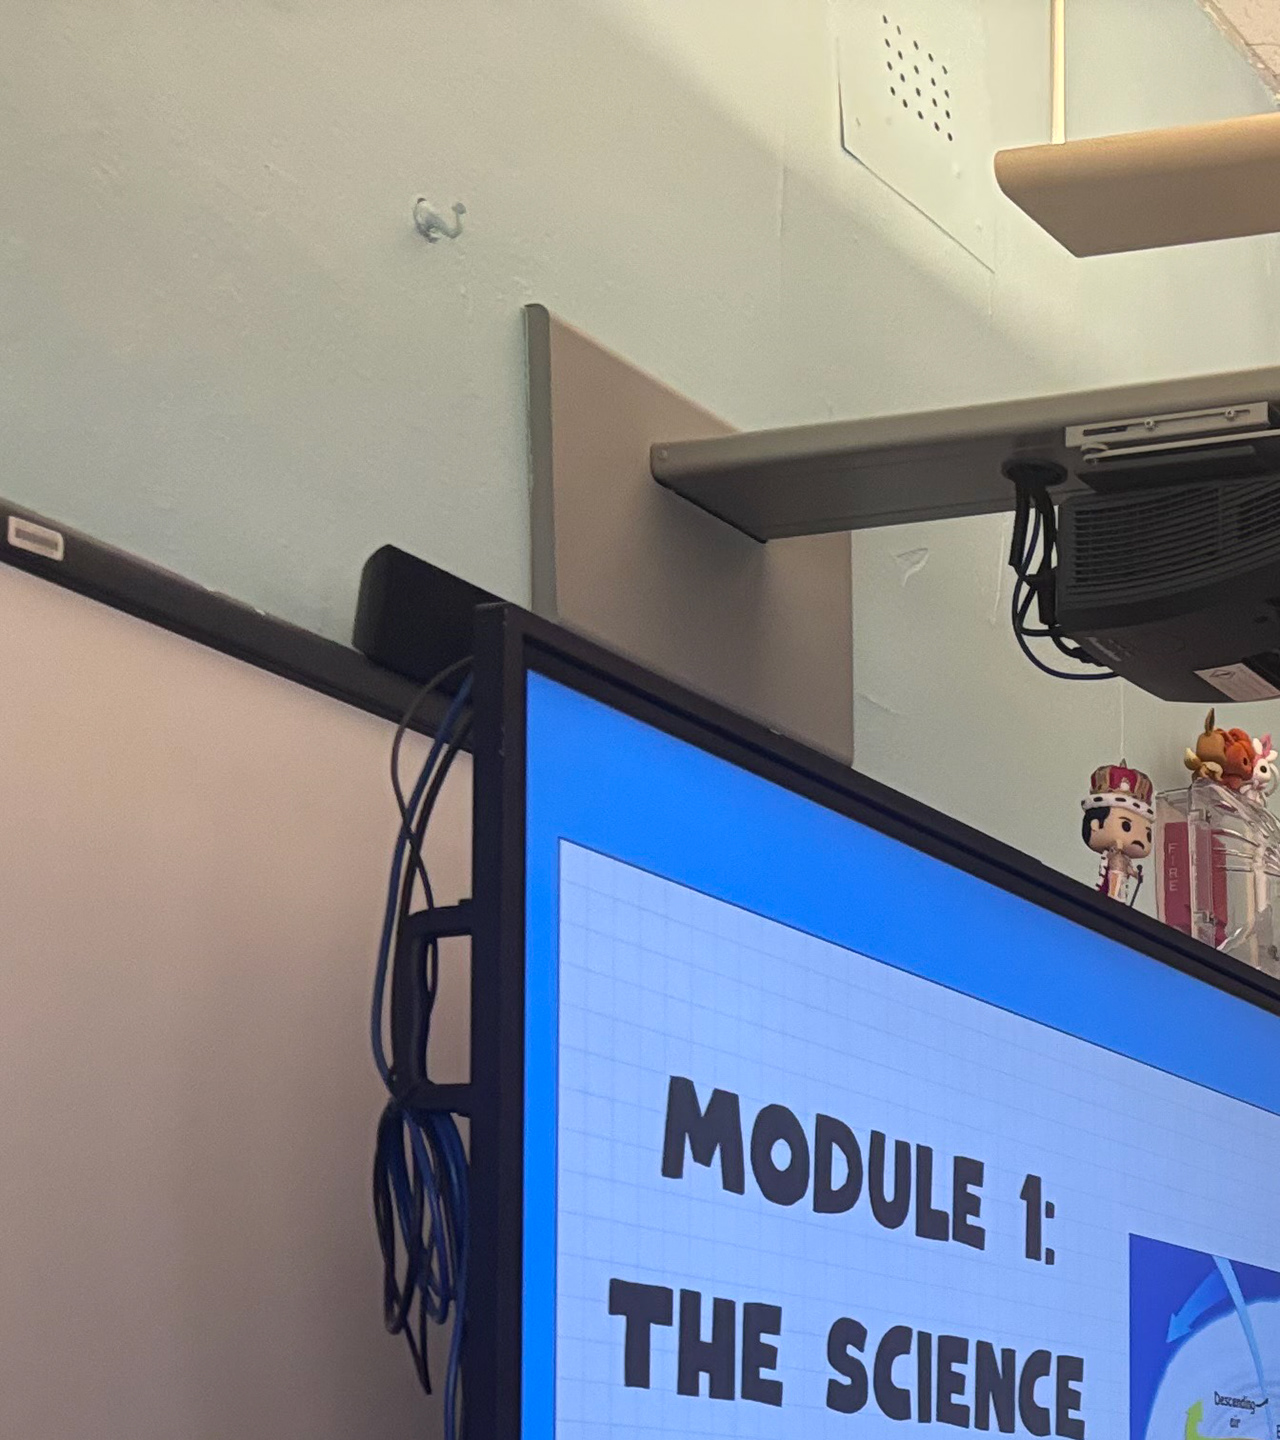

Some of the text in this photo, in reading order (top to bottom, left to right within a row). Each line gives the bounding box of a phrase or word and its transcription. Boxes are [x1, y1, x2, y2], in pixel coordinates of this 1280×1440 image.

[1168, 842, 1179, 892] FIRE
[660, 1075, 1056, 1266] MODULE 1:
[609, 1278, 784, 1407] THE
[1214, 1391, 1256, 1414] Descending
[1229, 1416, 1241, 1429] air
